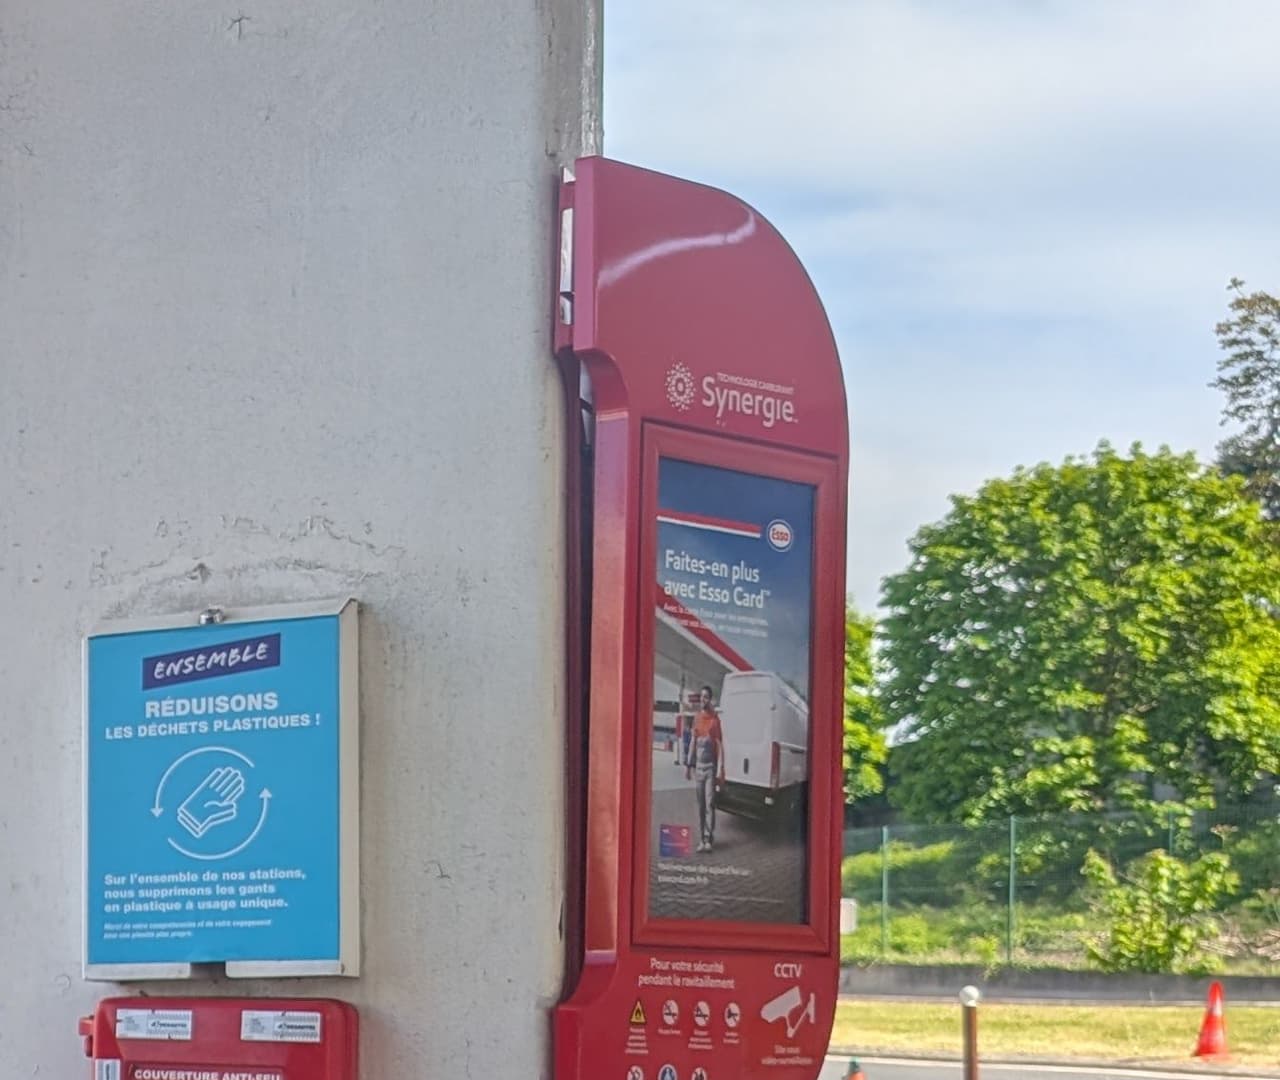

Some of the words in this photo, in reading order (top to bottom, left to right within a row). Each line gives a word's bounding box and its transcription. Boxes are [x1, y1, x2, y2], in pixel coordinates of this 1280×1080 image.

[701, 375, 795, 428] Synergie
[771, 527, 789, 543] Esso
[664, 549, 728, 578] Faites-en
[731, 560, 760, 585] plus
[663, 580, 696, 598] avec
[698, 581, 730, 604] Esso
[153, 641, 268, 680] ENSEMBLE
[144, 691, 279, 719] RÉDUISONS
[105, 726, 133, 740] LES
[213, 713, 311, 732] PLASTIQUES
[315, 713, 320, 725] !
[104, 873, 126, 886] Sur
[129, 869, 198, 885] l'ensemble
[202, 868, 218, 882] de
[222, 870, 245, 881] nos
[248, 867, 306, 881] stations,
[104, 888, 135, 900] nous
[137, 885, 212, 901] supprimons
[215, 884, 235, 896] les
[238, 884, 276, 897] gants
[104, 902, 120, 913] en
[123, 899, 182, 914] plastique
[185, 899, 196, 911] à
[197, 900, 237, 912] usage
[240, 897, 289, 911] unique.
[650, 957, 670, 970] Pour
[671, 961, 692, 972] votre
[773, 962, 803, 978] CCTV
[638, 974, 672, 987] pendant
[673, 975, 682, 986] le
